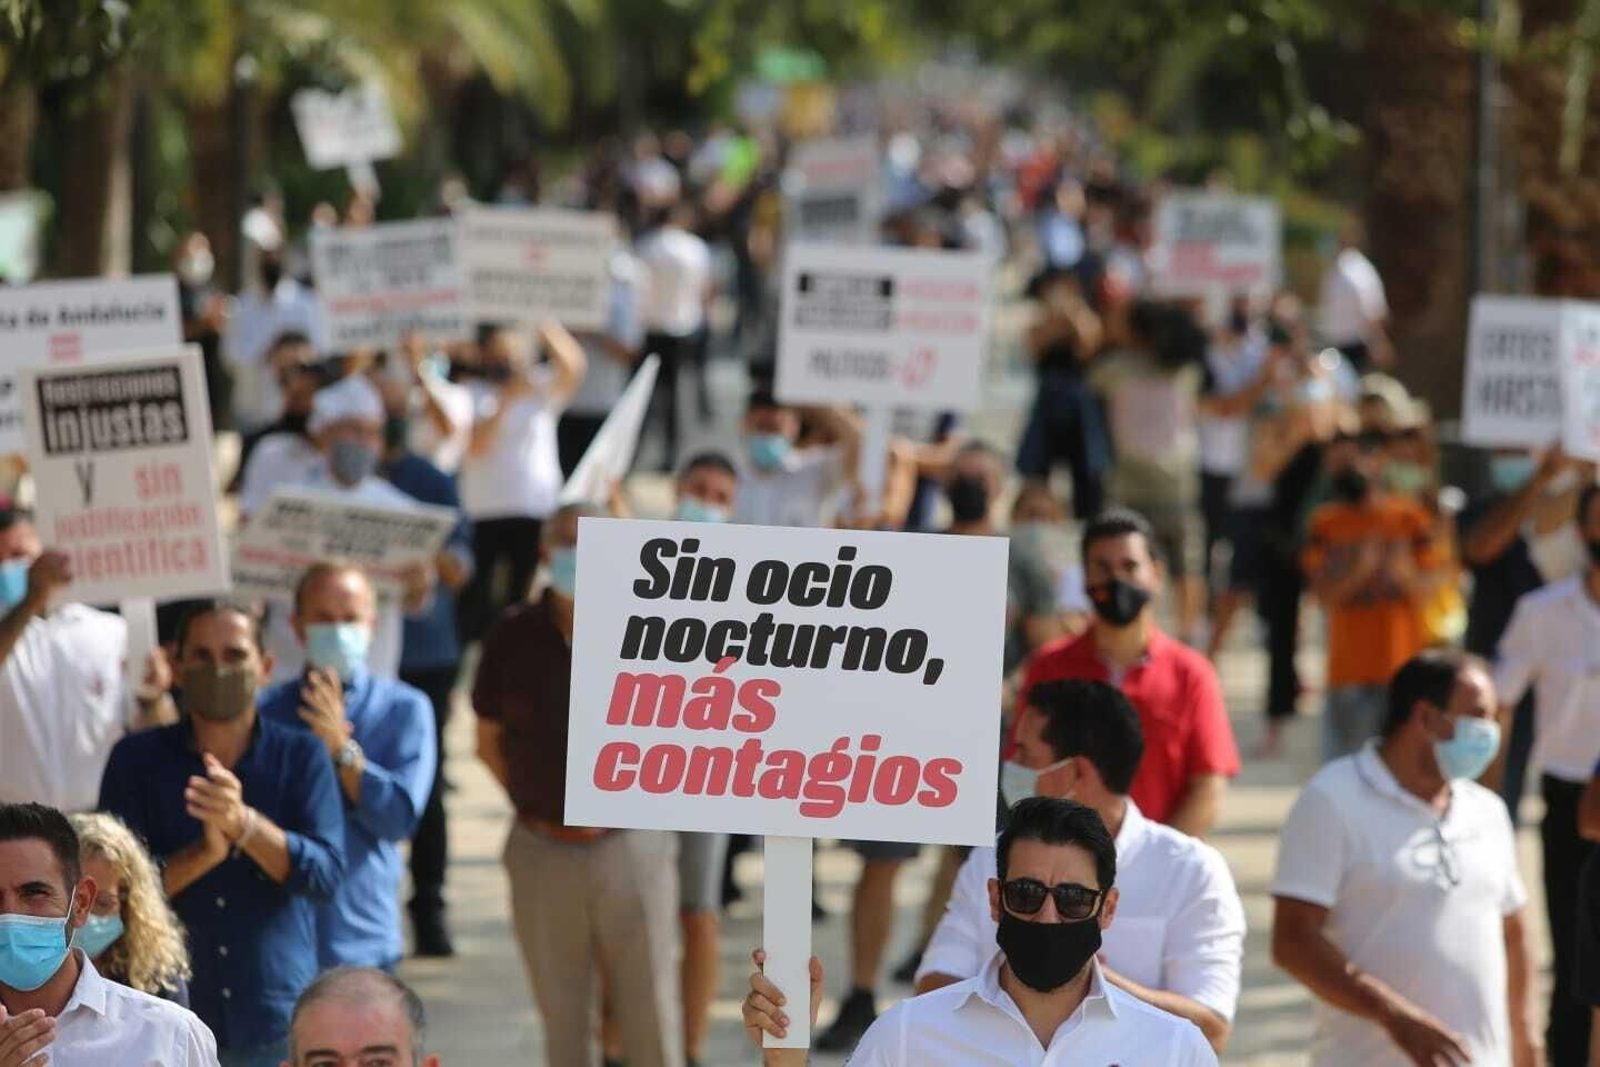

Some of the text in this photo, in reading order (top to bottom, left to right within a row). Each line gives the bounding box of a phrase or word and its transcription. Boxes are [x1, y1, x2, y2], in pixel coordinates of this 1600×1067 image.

[133, 462, 183, 499] sin
[632, 537, 893, 610] Sin ocio
[619, 612, 945, 685] nocturno,
[605, 656, 782, 733] más
[592, 734, 965, 819] contagios
